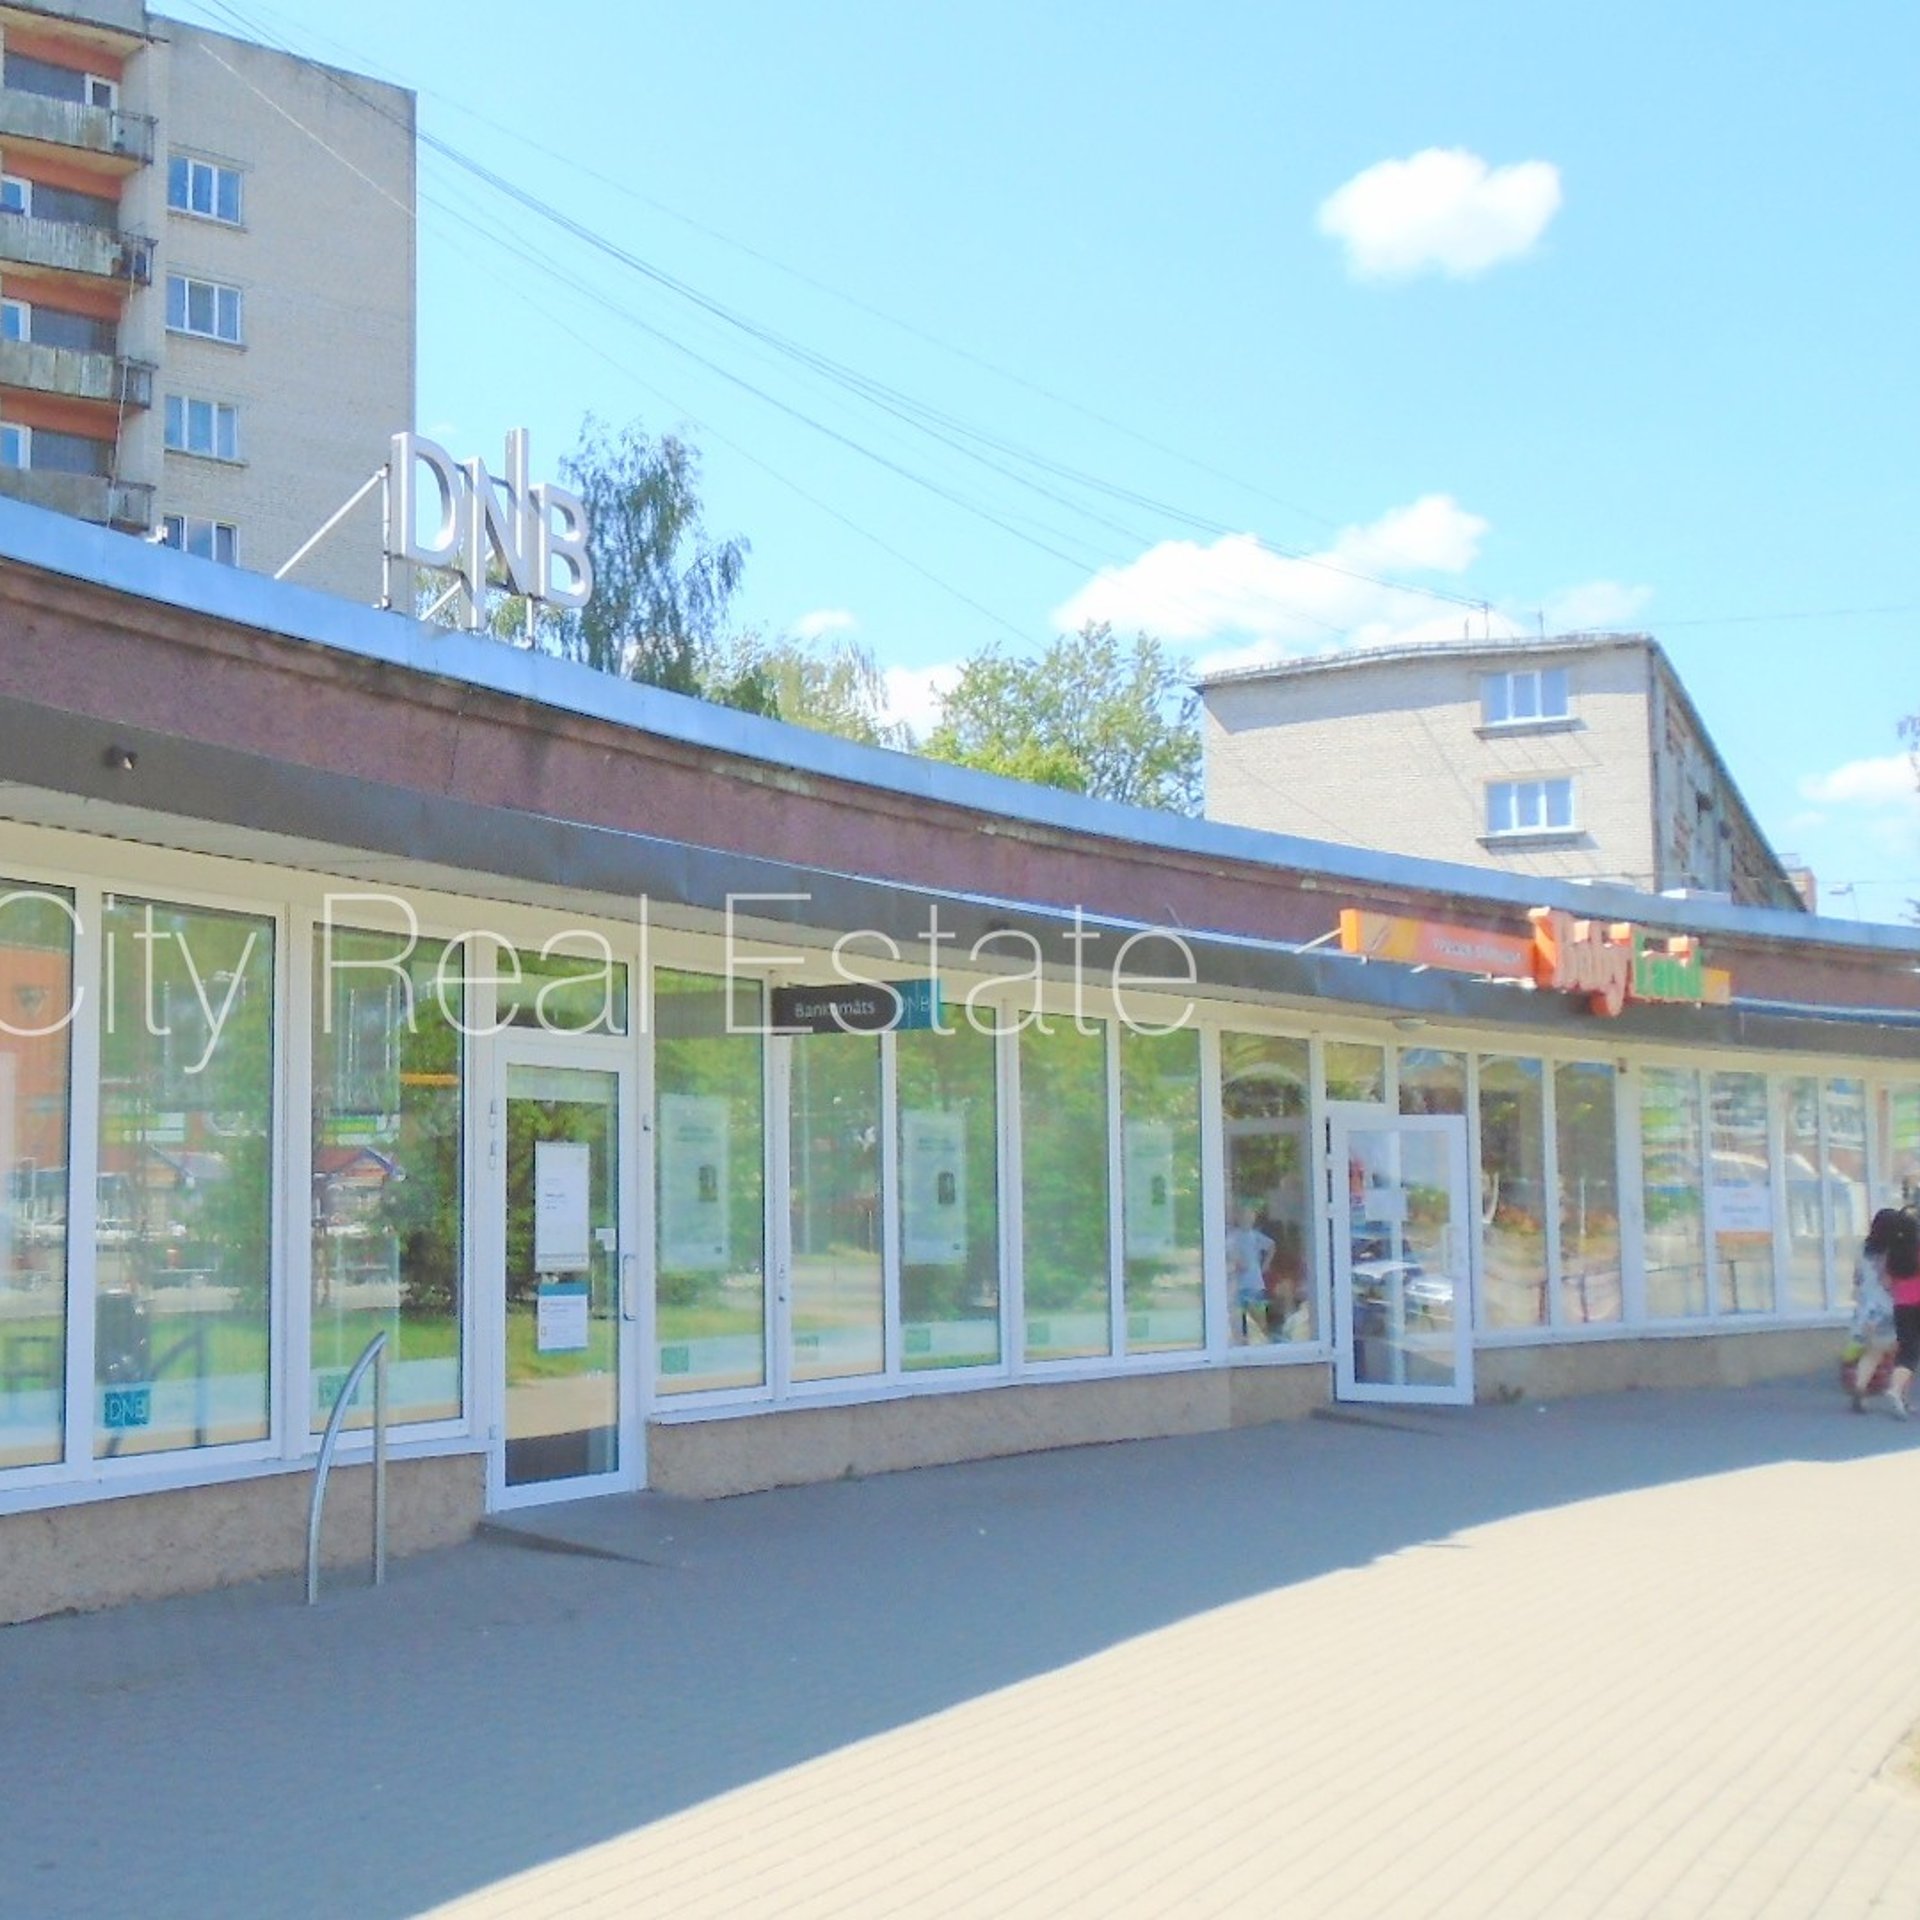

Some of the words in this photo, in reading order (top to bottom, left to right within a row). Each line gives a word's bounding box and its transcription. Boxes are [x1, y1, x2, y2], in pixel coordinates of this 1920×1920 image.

[391, 428, 593, 629] DNB
[795, 999, 875, 1018] Bankmāts
[110, 1393, 145, 1426] DNB
